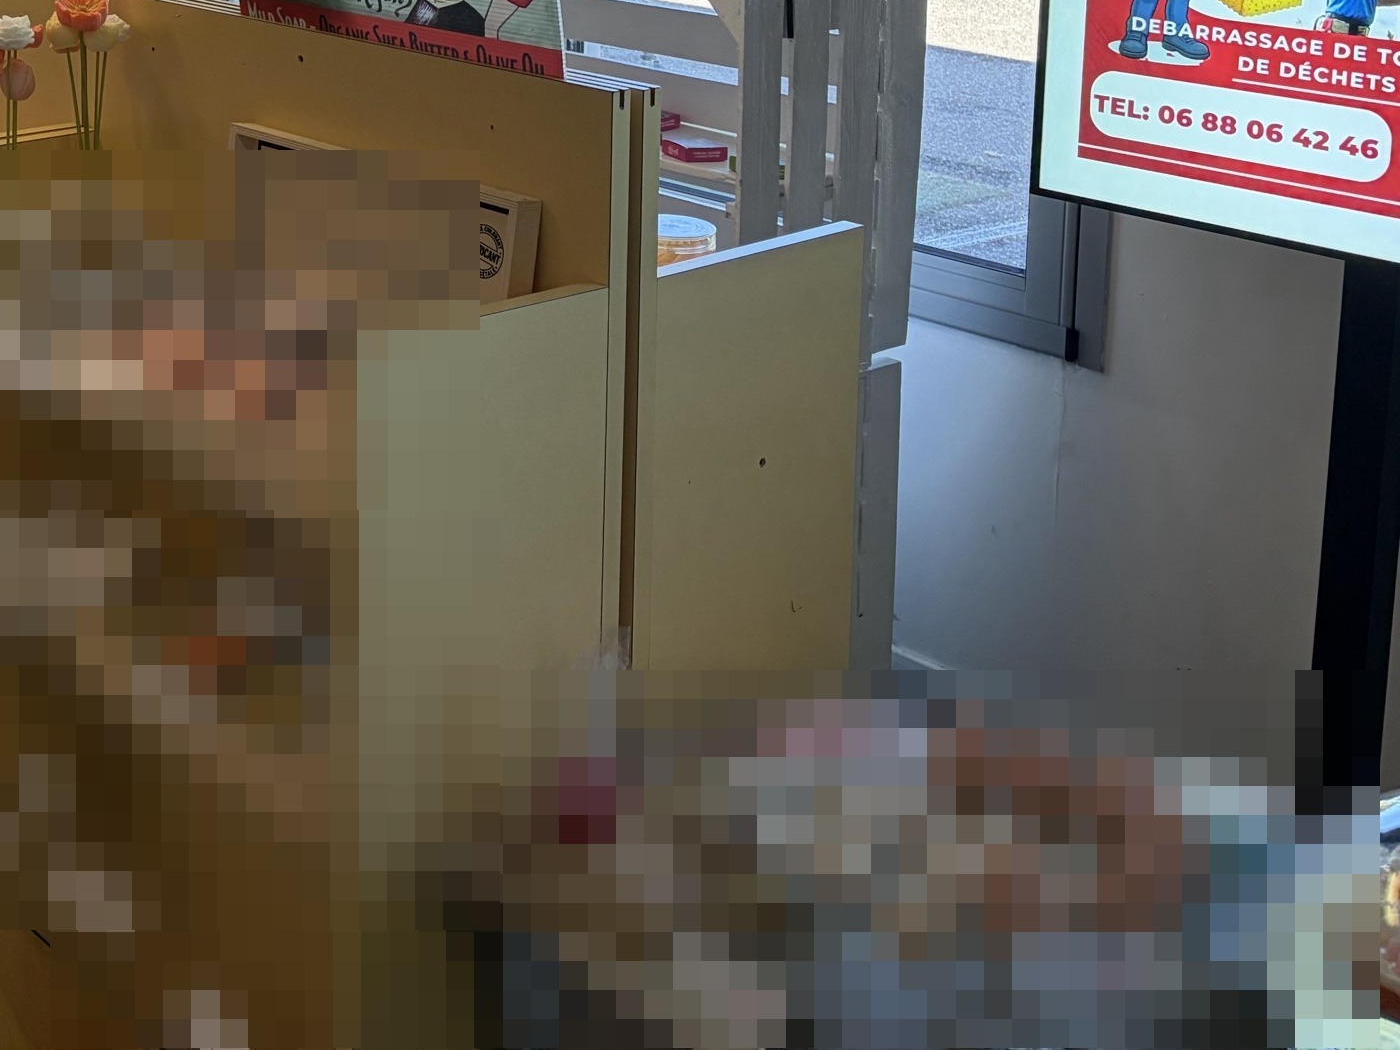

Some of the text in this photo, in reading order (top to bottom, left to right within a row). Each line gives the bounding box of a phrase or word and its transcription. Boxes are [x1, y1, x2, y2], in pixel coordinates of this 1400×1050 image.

[1131, 16, 1323, 56] DEBARRASSAGE
[1334, 42, 1367, 62] DE
[1237, 56, 1396, 93] DE DÉCHETS
[1094, 94, 1379, 160] TEL: 06 88 06 42 46
